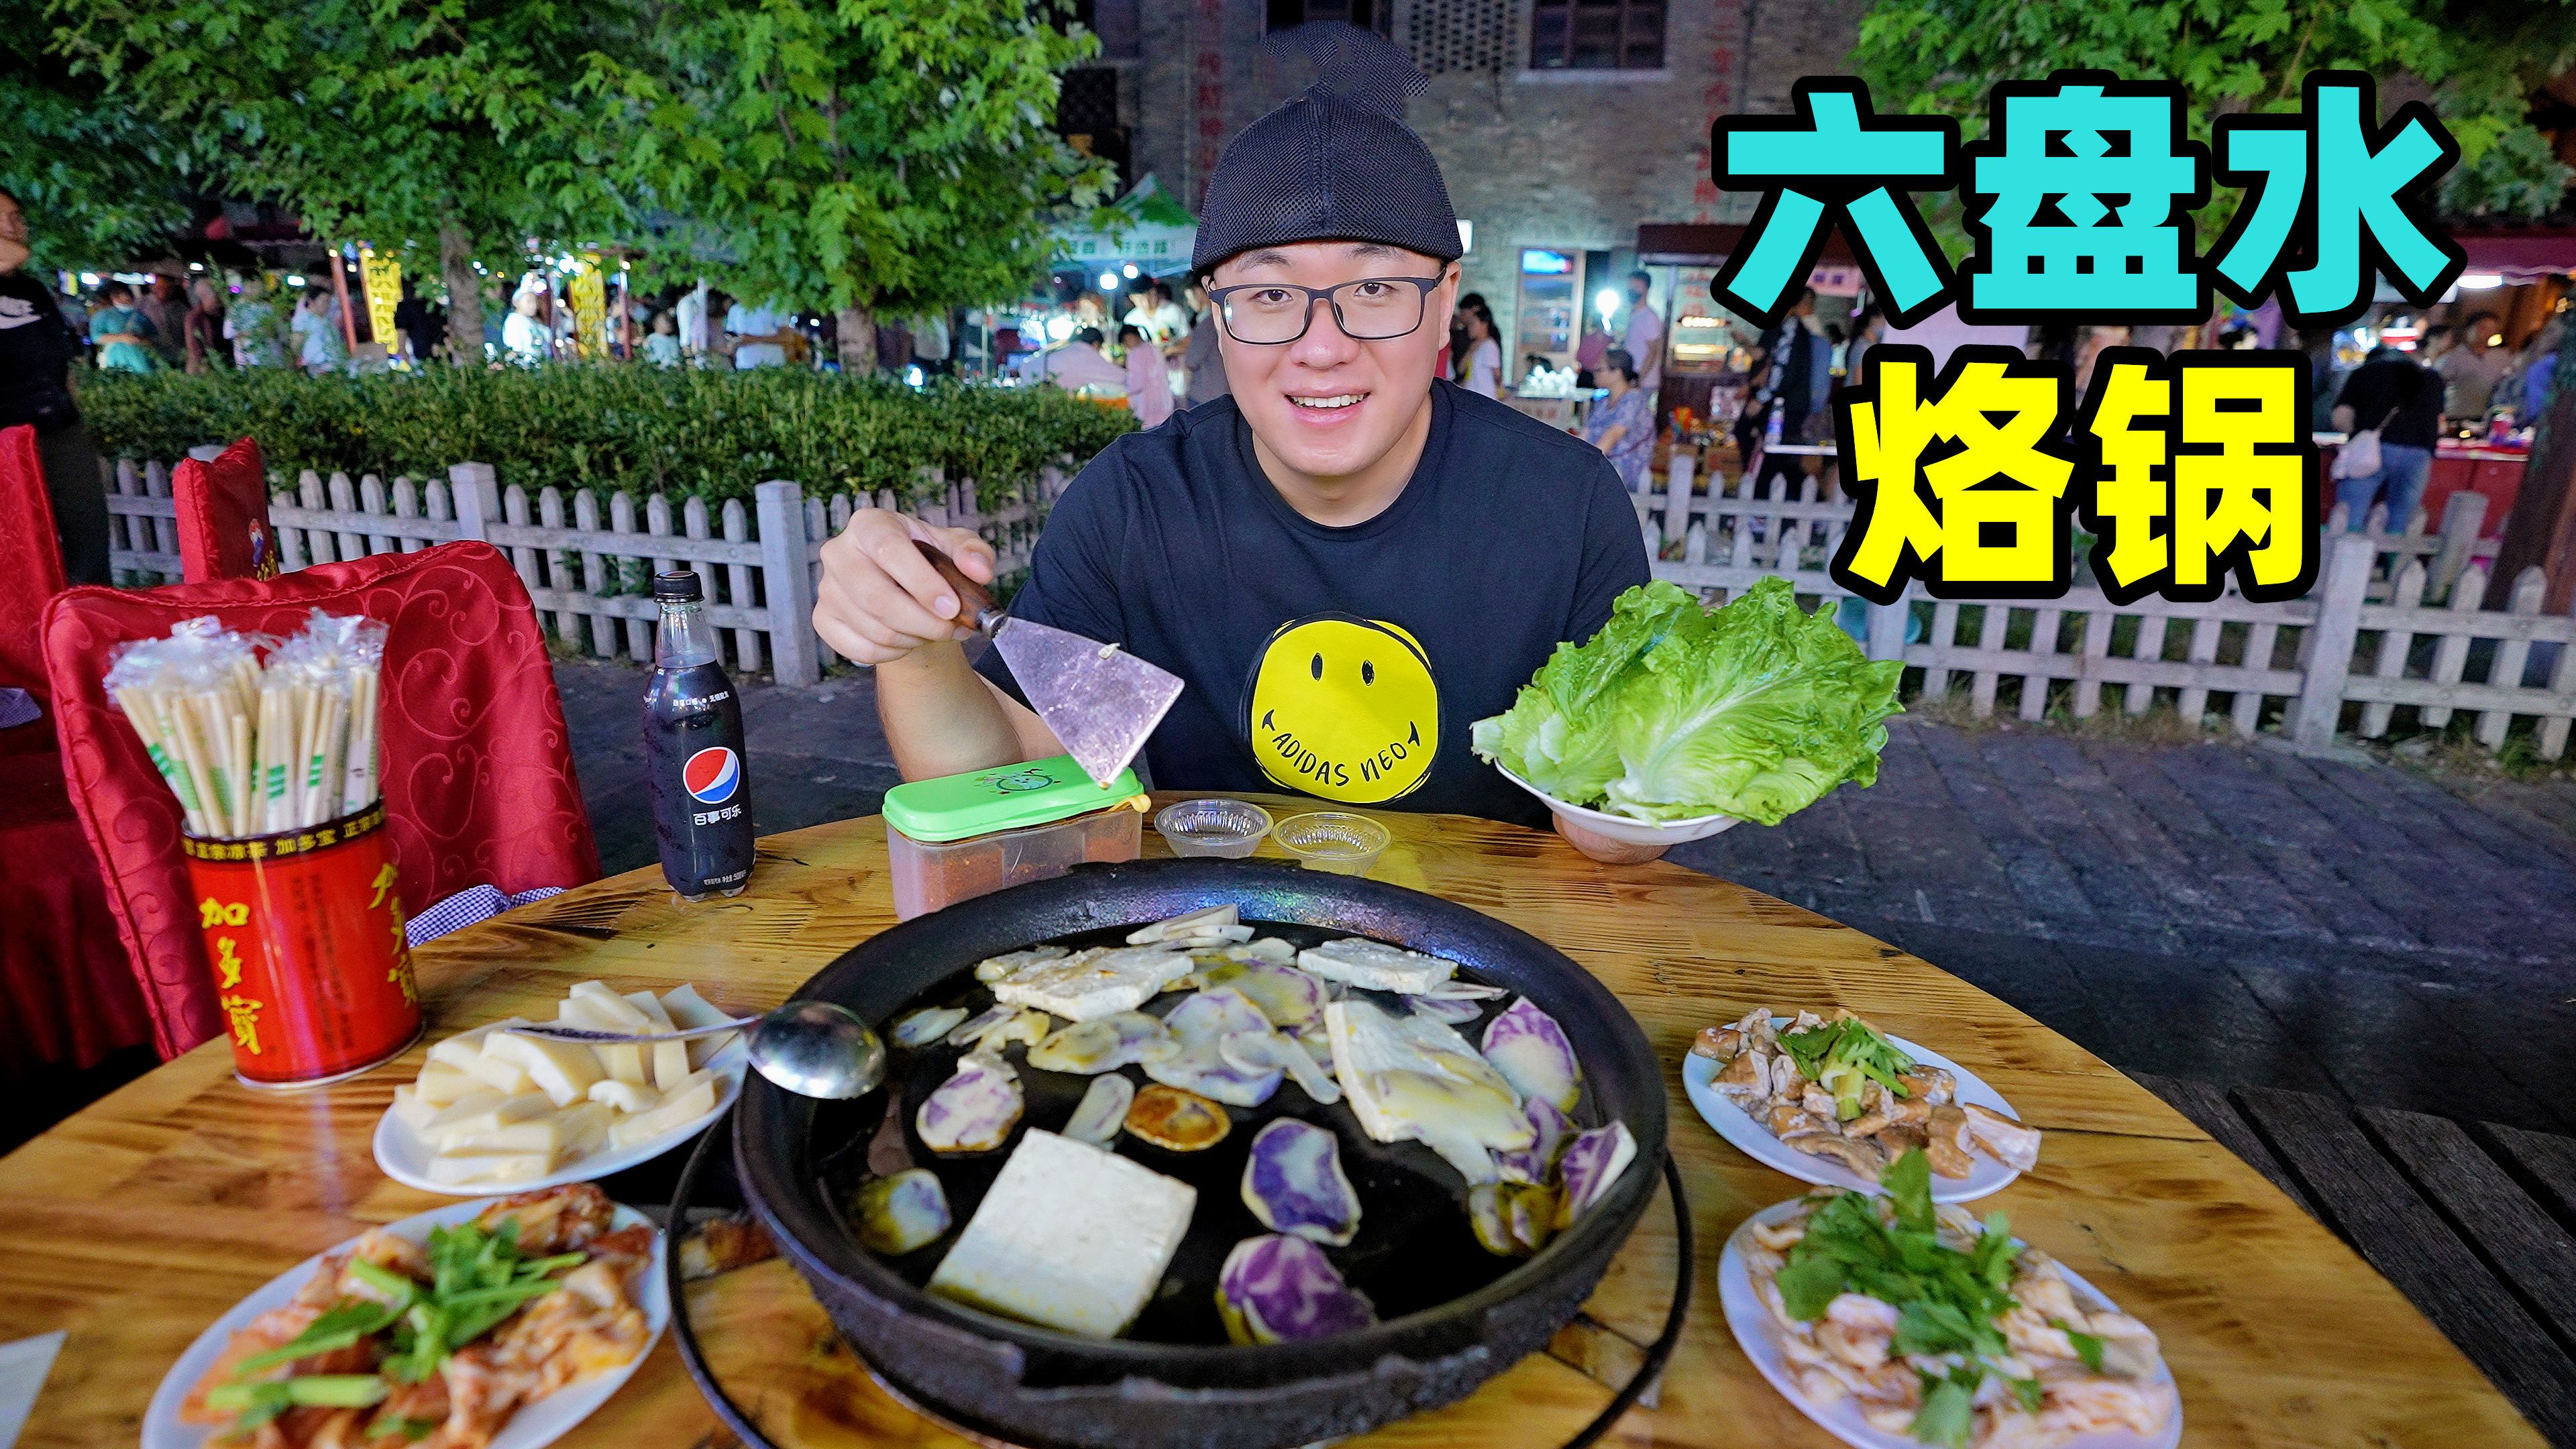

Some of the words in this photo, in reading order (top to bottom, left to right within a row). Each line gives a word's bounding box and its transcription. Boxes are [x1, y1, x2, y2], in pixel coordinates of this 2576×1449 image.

[1272, 733, 1350, 787] ADIDAS
[692, 804, 742, 826] 百事可乐
[275, 828, 337, 856] 加多宝
